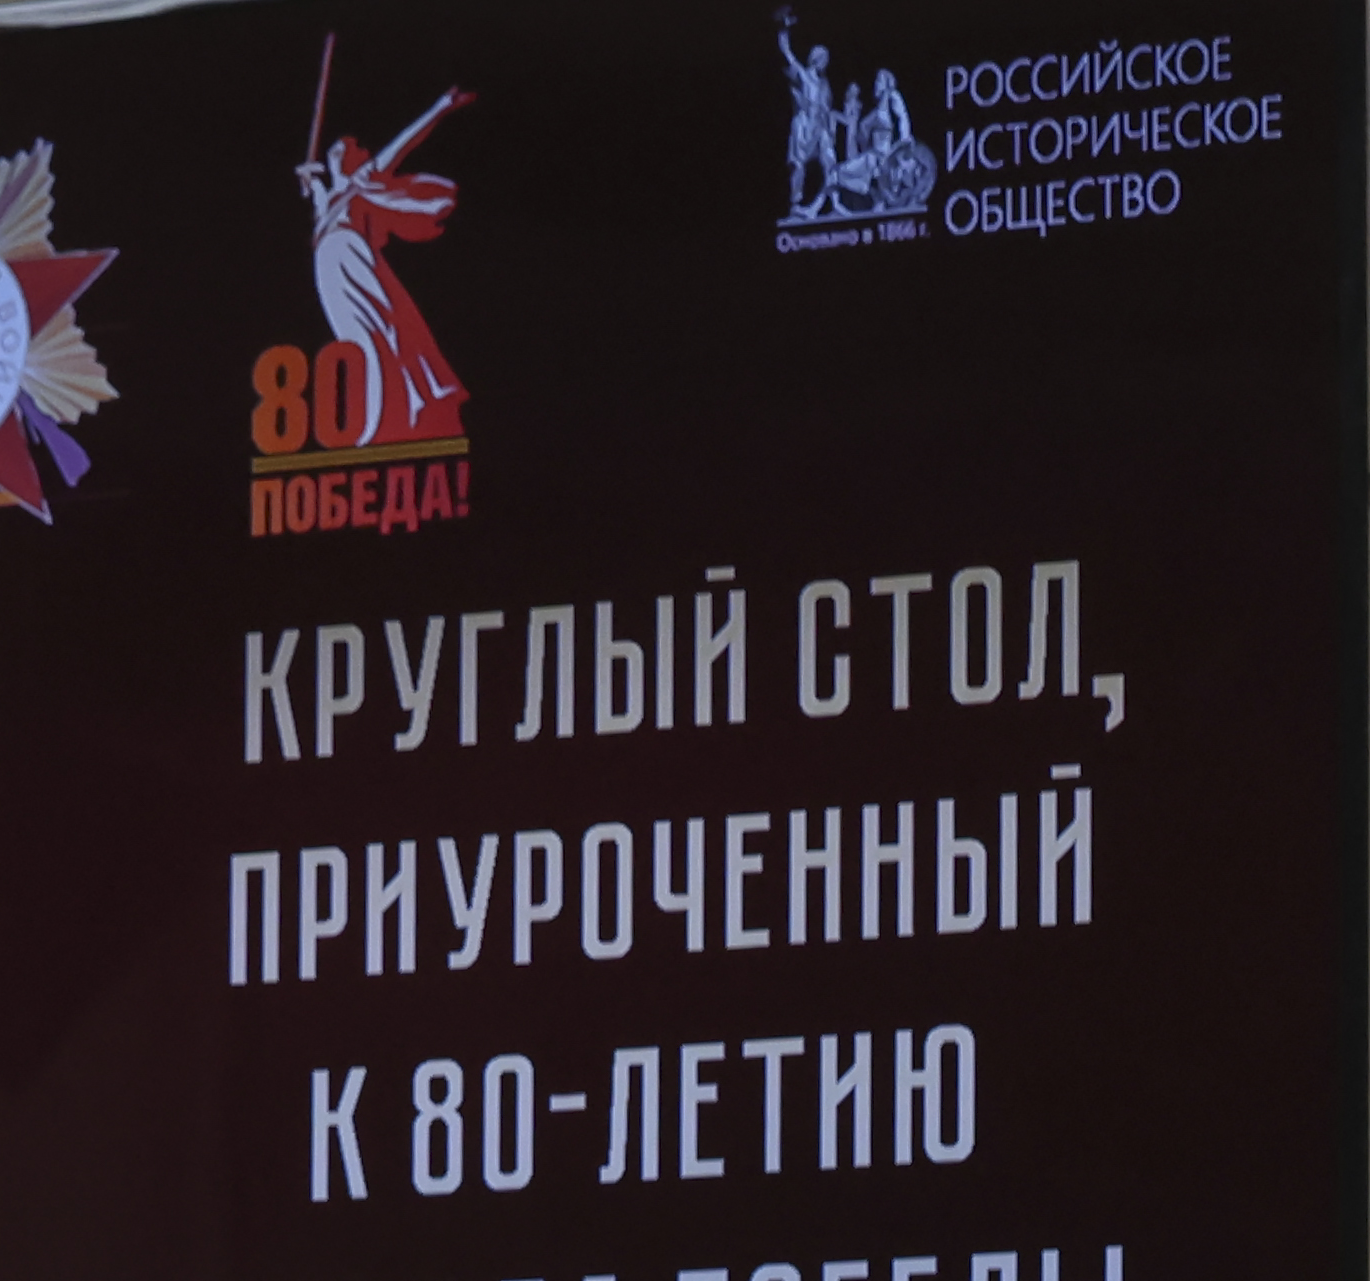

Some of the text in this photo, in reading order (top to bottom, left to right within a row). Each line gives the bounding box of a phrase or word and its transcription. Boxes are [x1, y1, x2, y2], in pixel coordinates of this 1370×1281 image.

[945, 36, 1232, 110] РОССИЙСКОЕ
[945, 94, 1283, 173] ИСТОРИЧЕСКОЕ
[944, 169, 1182, 238] ОБЩЕСТВО
[251, 340, 368, 455] 80
[250, 461, 471, 538] ПОБЕДА!
[244, 561, 1125, 763] КРУГЛЫЙ СТОЛ,
[229, 764, 1092, 986] ПРИУРОЧЕННЫЙ
[310, 1024, 976, 1203] К 80-ЛЕТИЮ
